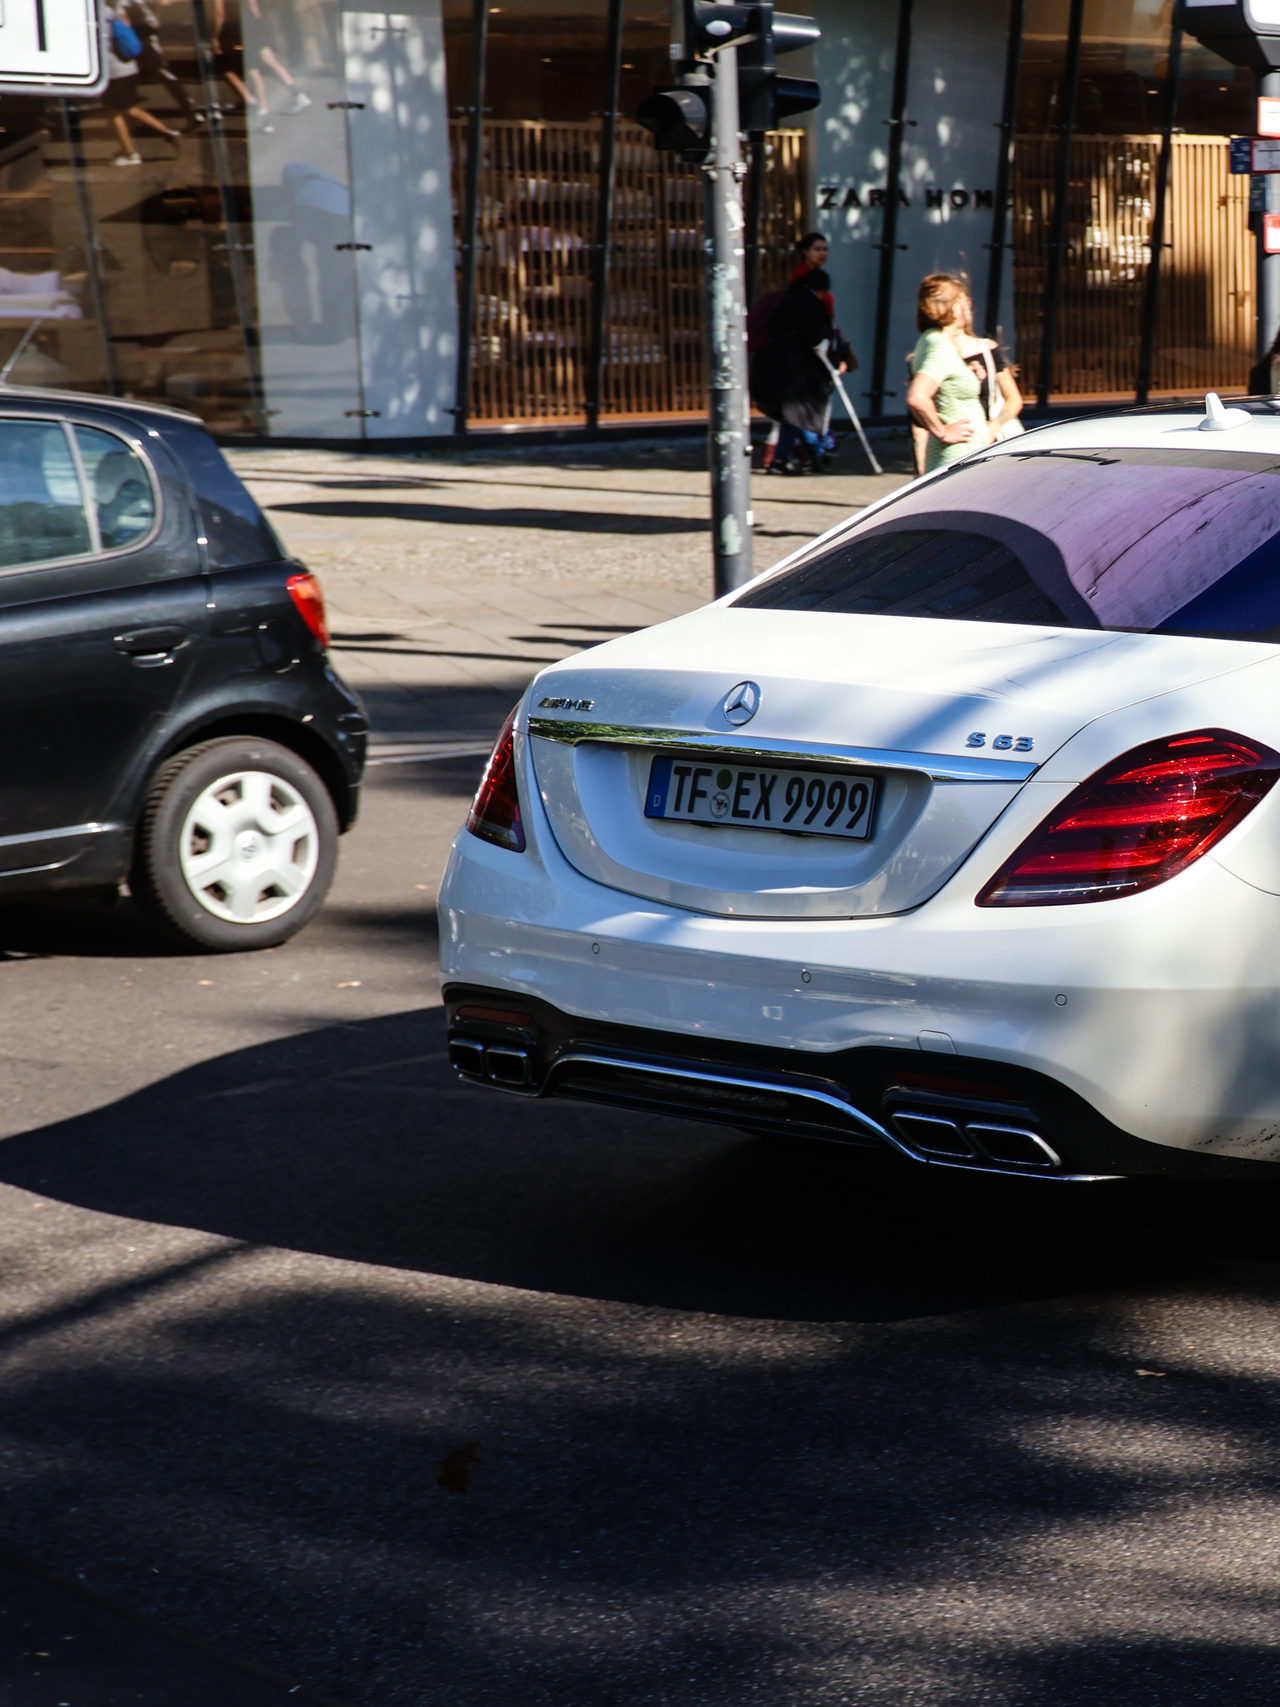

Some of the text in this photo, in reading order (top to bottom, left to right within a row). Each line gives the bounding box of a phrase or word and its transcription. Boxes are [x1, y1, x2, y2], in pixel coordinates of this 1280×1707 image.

[967, 732, 1035, 752] S 63
[653, 794, 661, 807] D
[673, 765, 869, 829] TF EX 9999
